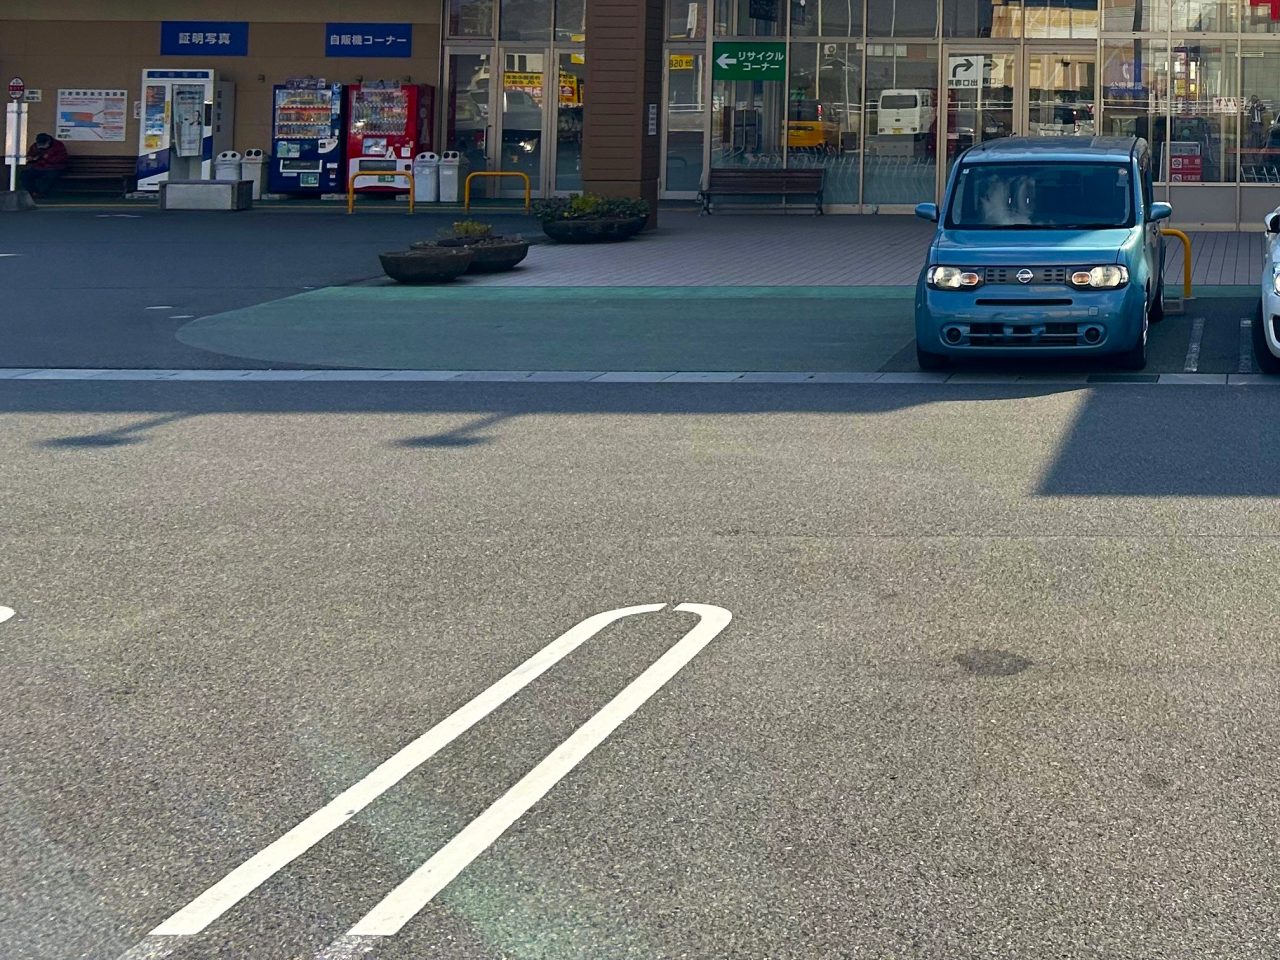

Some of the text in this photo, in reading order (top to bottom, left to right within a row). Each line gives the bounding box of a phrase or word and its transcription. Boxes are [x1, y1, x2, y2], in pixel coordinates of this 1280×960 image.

[178, 32, 231, 45] 証明写真
[329, 34, 407, 46] 自販機コーナー
[738, 51, 784, 61] リサイクル
[742, 63, 780, 71] コーナー
